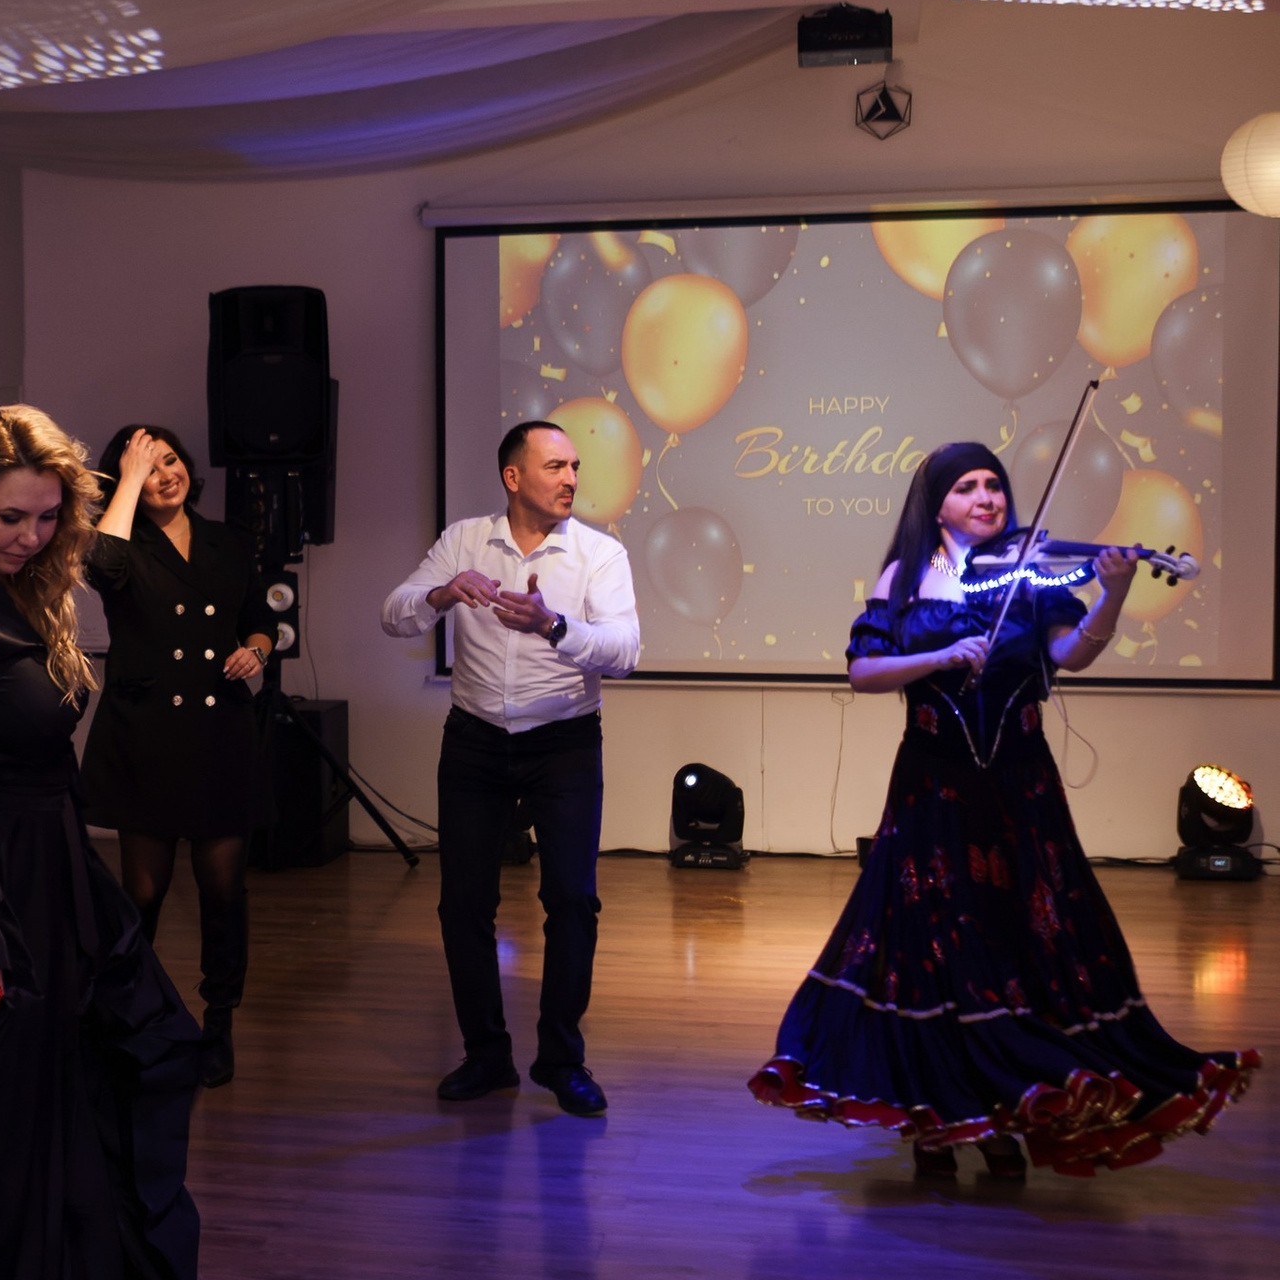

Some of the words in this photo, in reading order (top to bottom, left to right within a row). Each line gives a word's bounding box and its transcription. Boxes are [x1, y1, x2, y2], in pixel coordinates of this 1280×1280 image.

[808, 395, 891, 416] HAPPY
[733, 425, 928, 479] Birthda
[801, 496, 835, 517] TO
[840, 496, 892, 517] YOU
